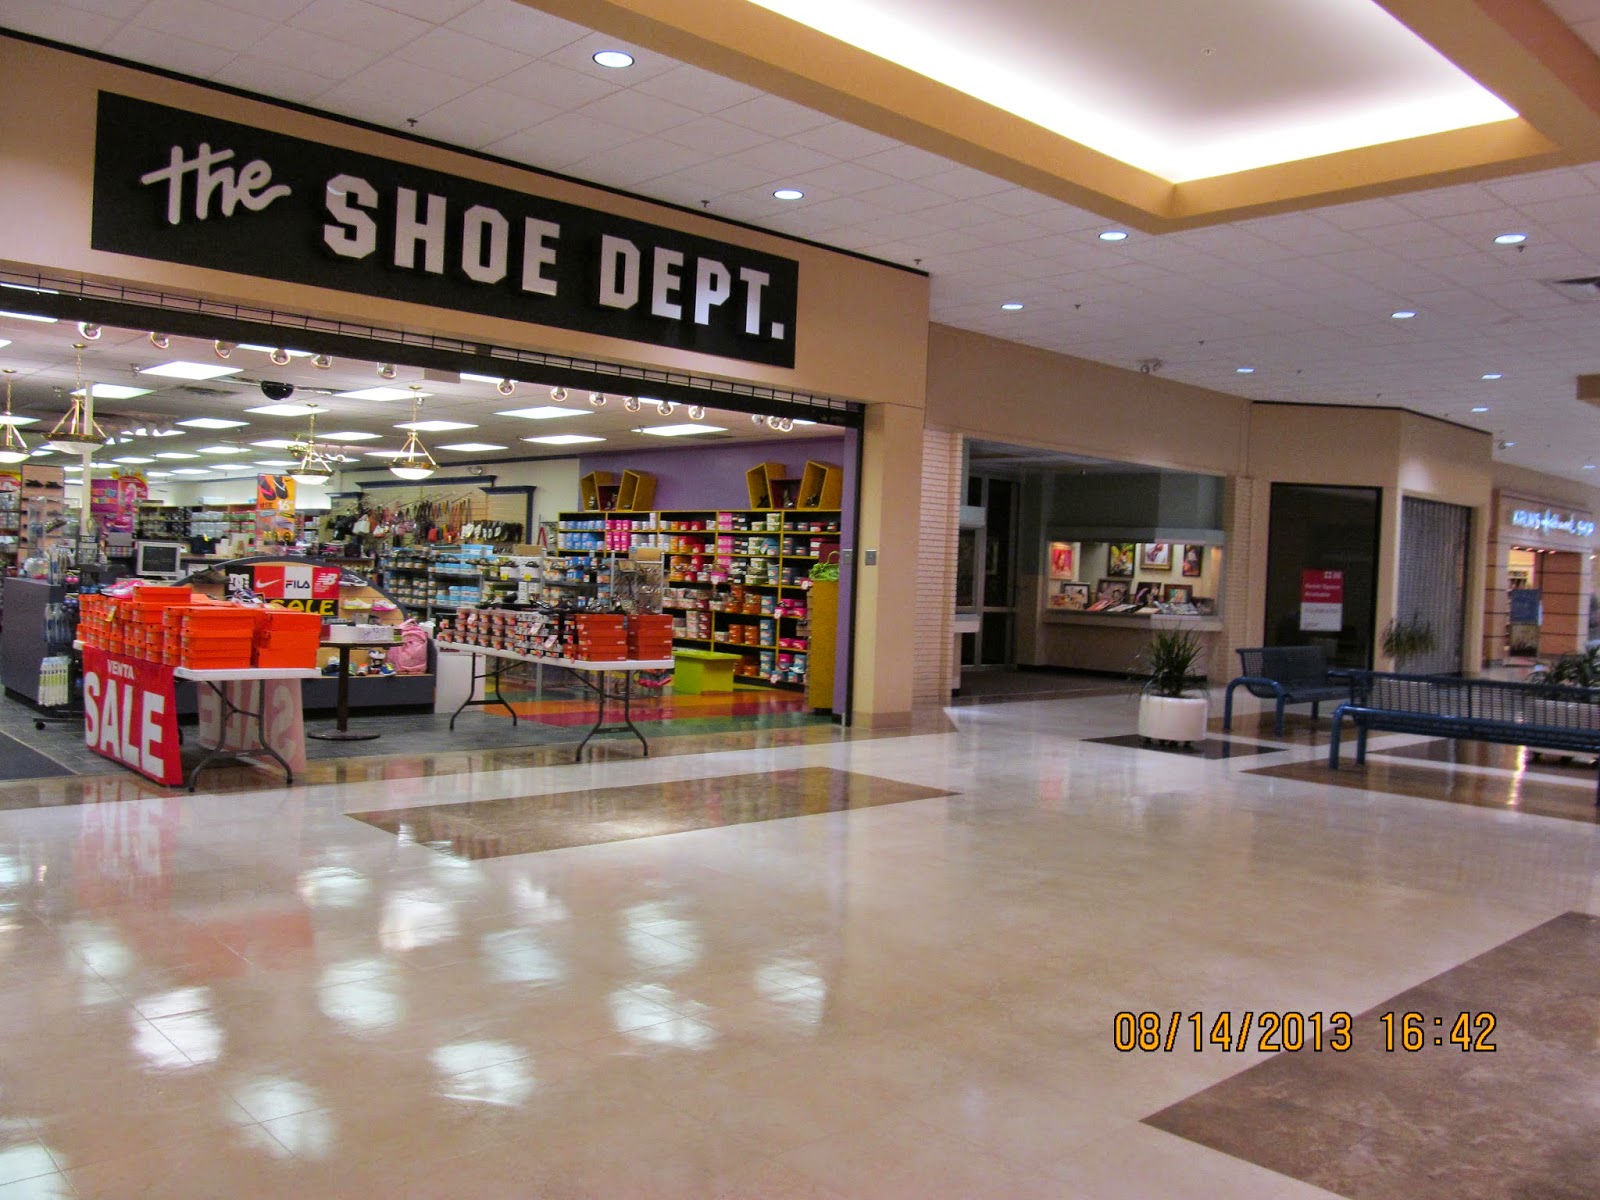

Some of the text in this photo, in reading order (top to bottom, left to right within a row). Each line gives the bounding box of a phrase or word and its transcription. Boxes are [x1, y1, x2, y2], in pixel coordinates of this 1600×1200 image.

[141, 142, 785, 340] the SHOE DEPT.
[285, 580, 311, 589] FILA
[107, 659, 135, 680] VENTA
[84, 671, 166, 778] SALE
